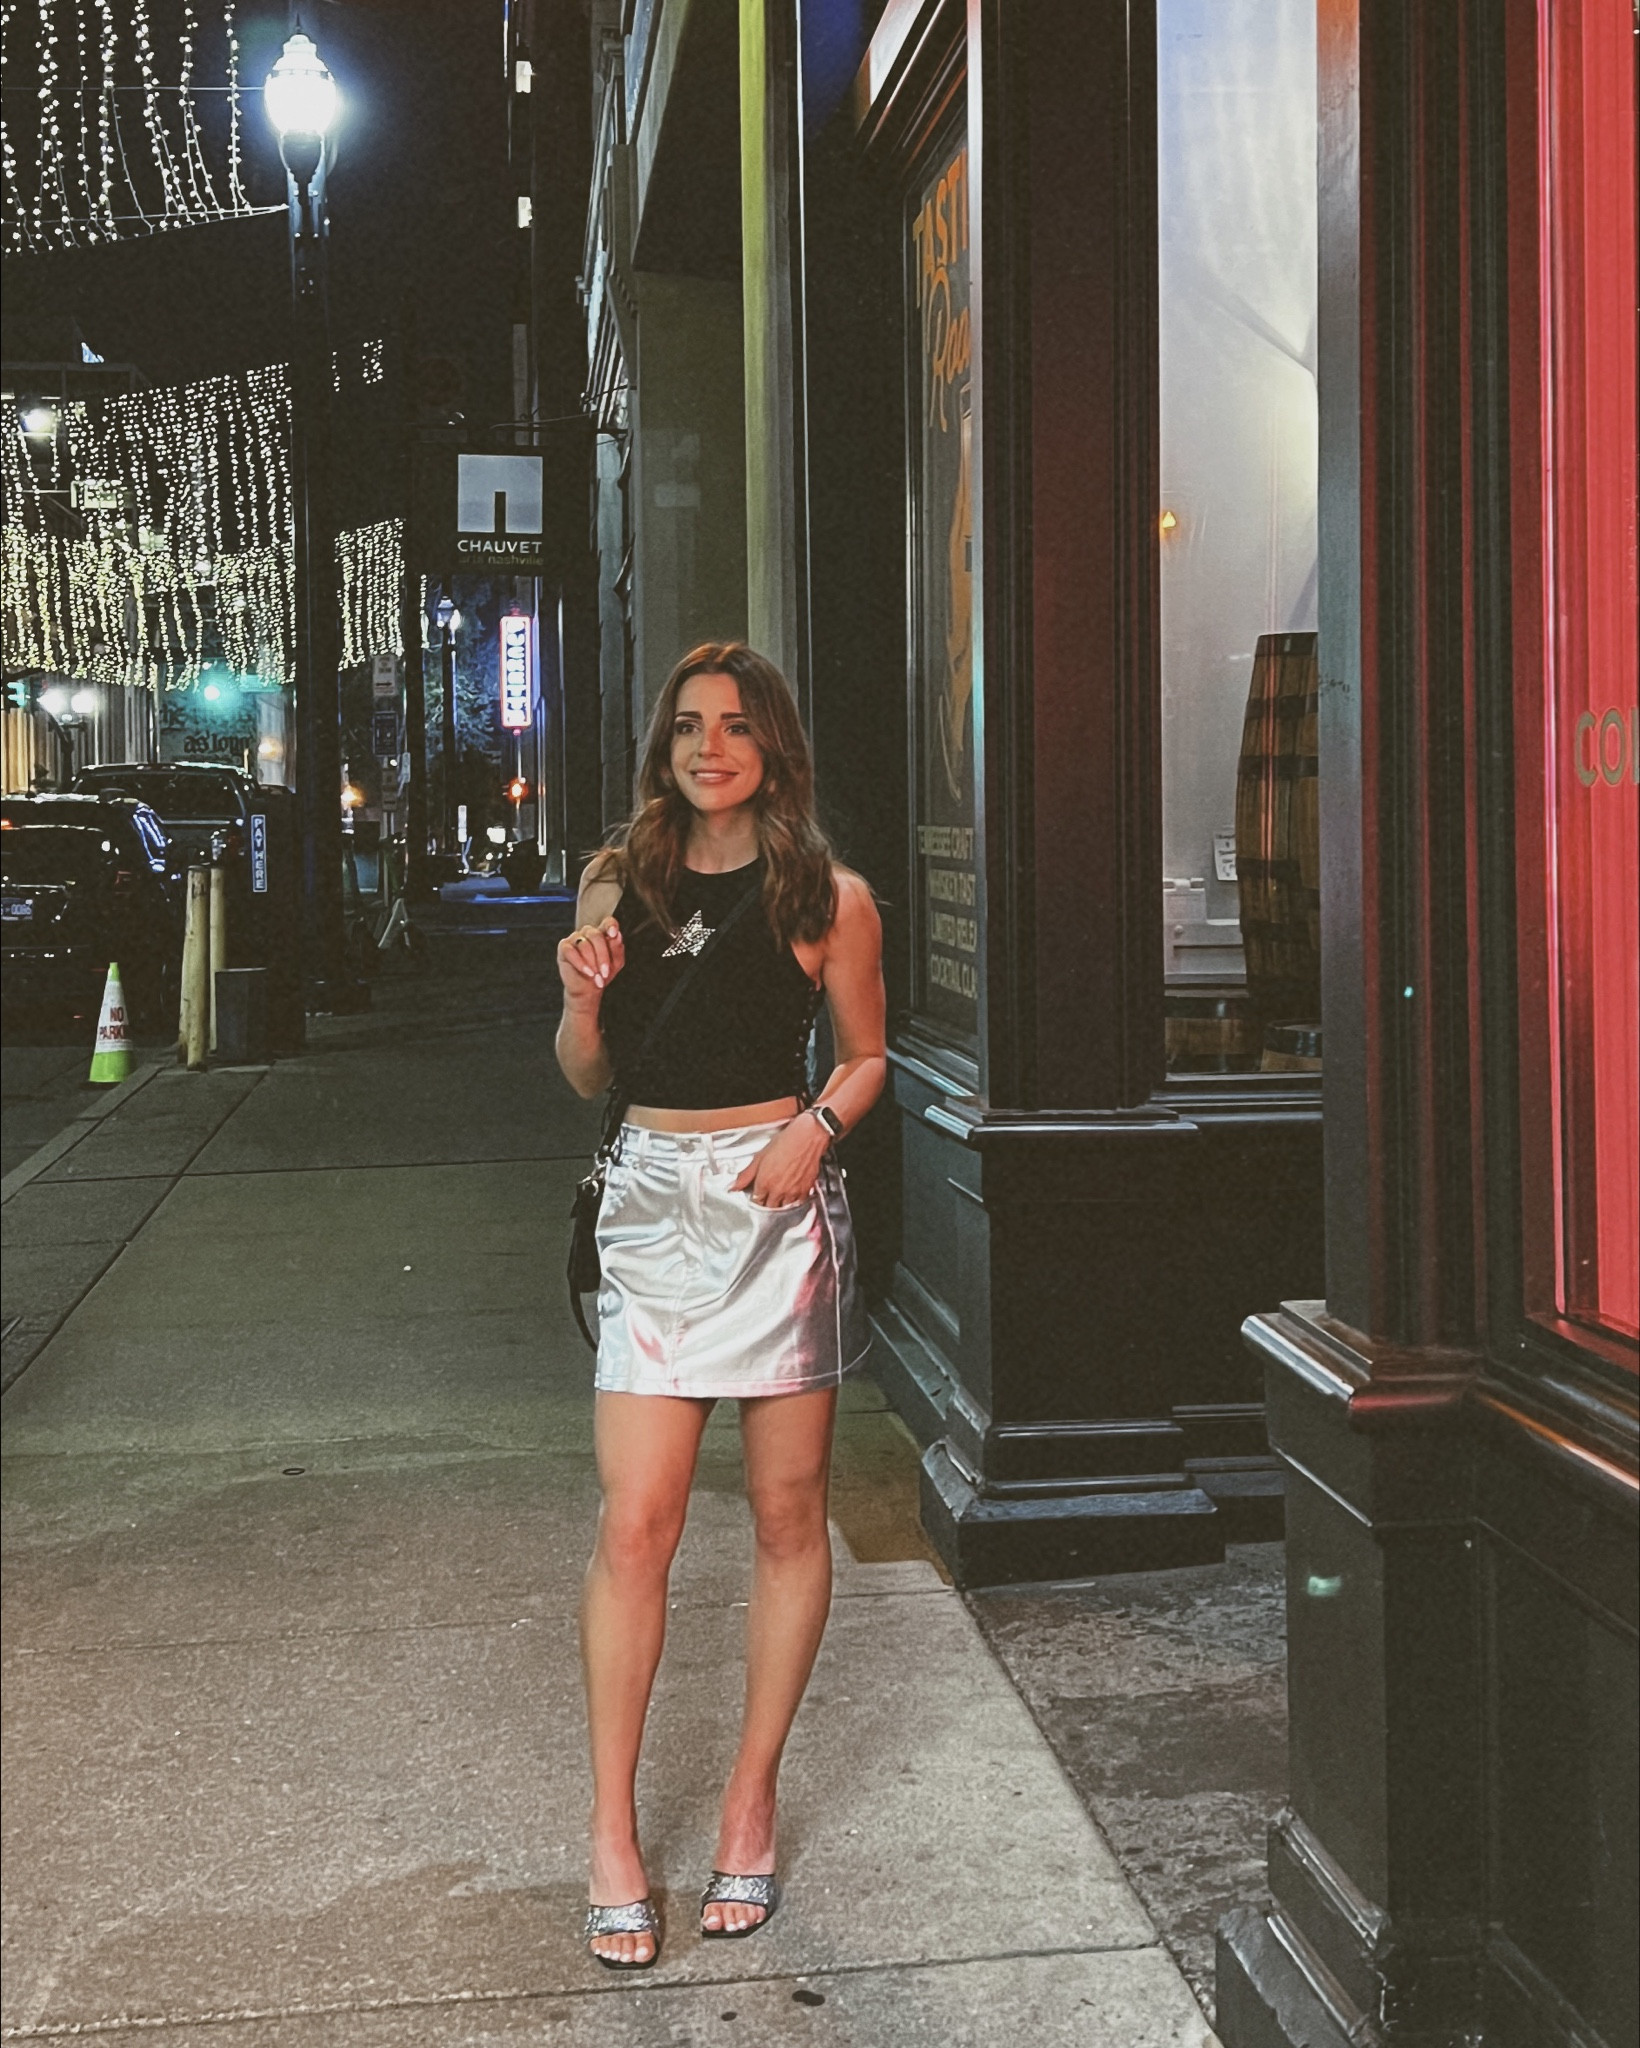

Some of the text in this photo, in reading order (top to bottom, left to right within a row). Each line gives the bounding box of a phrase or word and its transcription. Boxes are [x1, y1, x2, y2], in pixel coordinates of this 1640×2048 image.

[456, 539, 543, 554] CHAUVET
[488, 555, 545, 566] nashville
[254, 818, 265, 889] PAY HERE
[109, 1006, 124, 1022] NO
